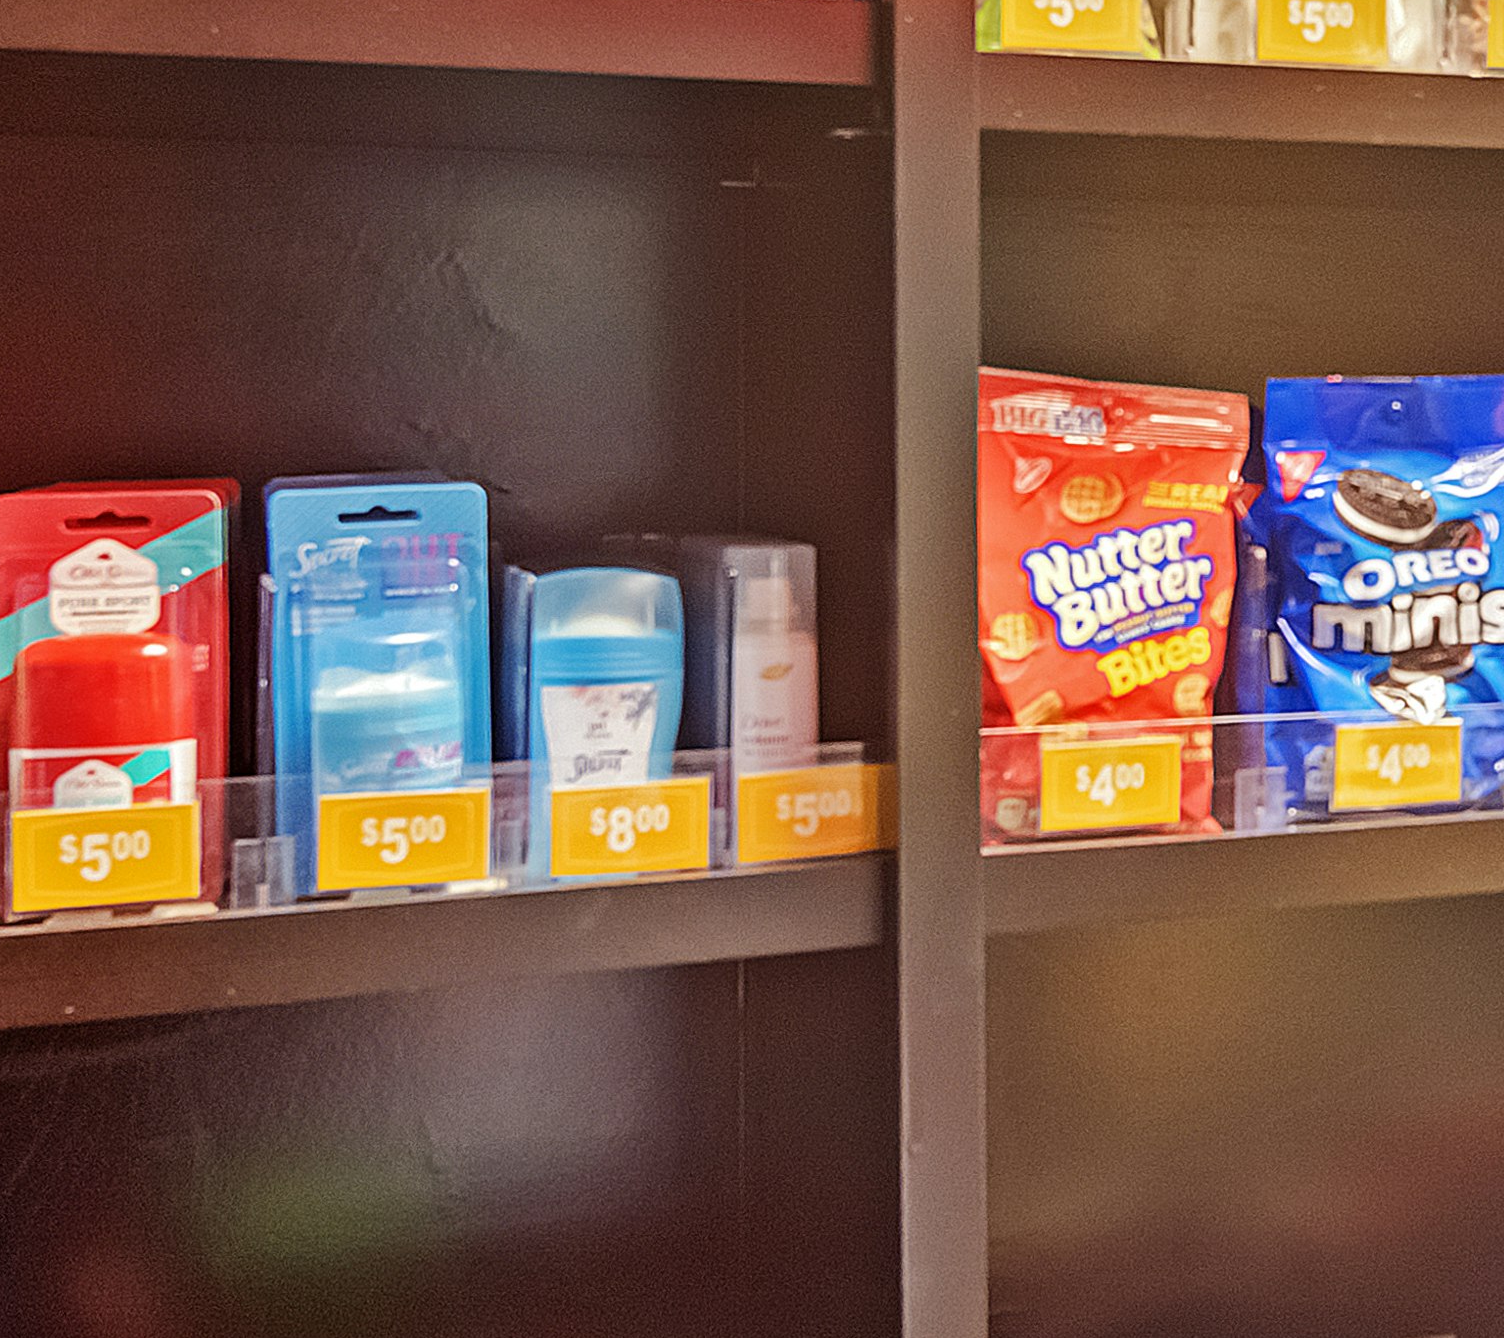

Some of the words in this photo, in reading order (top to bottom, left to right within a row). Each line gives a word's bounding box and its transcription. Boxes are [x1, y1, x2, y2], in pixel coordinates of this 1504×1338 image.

[1025, 521, 1193, 605] Nutter
[1053, 556, 1213, 647] Butter
[1344, 547, 1492, 603] OREO
[1096, 627, 1211, 698] Bites
